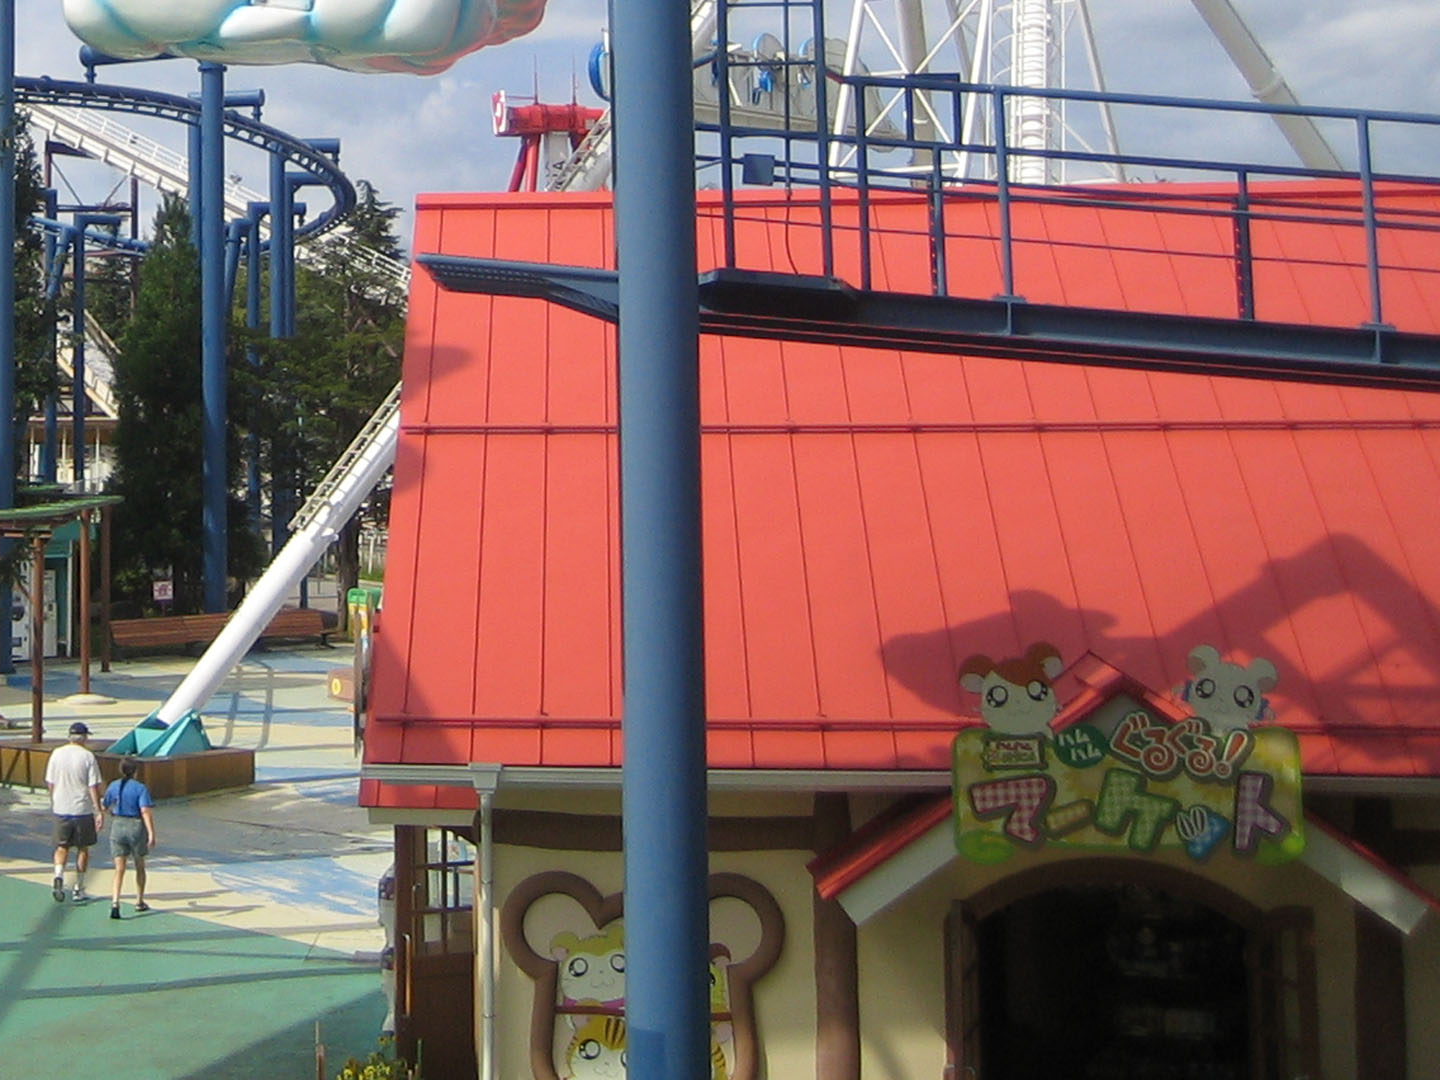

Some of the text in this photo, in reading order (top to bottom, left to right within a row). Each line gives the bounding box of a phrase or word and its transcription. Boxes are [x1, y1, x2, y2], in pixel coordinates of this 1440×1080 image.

[971, 772, 1285, 859] マーケット
